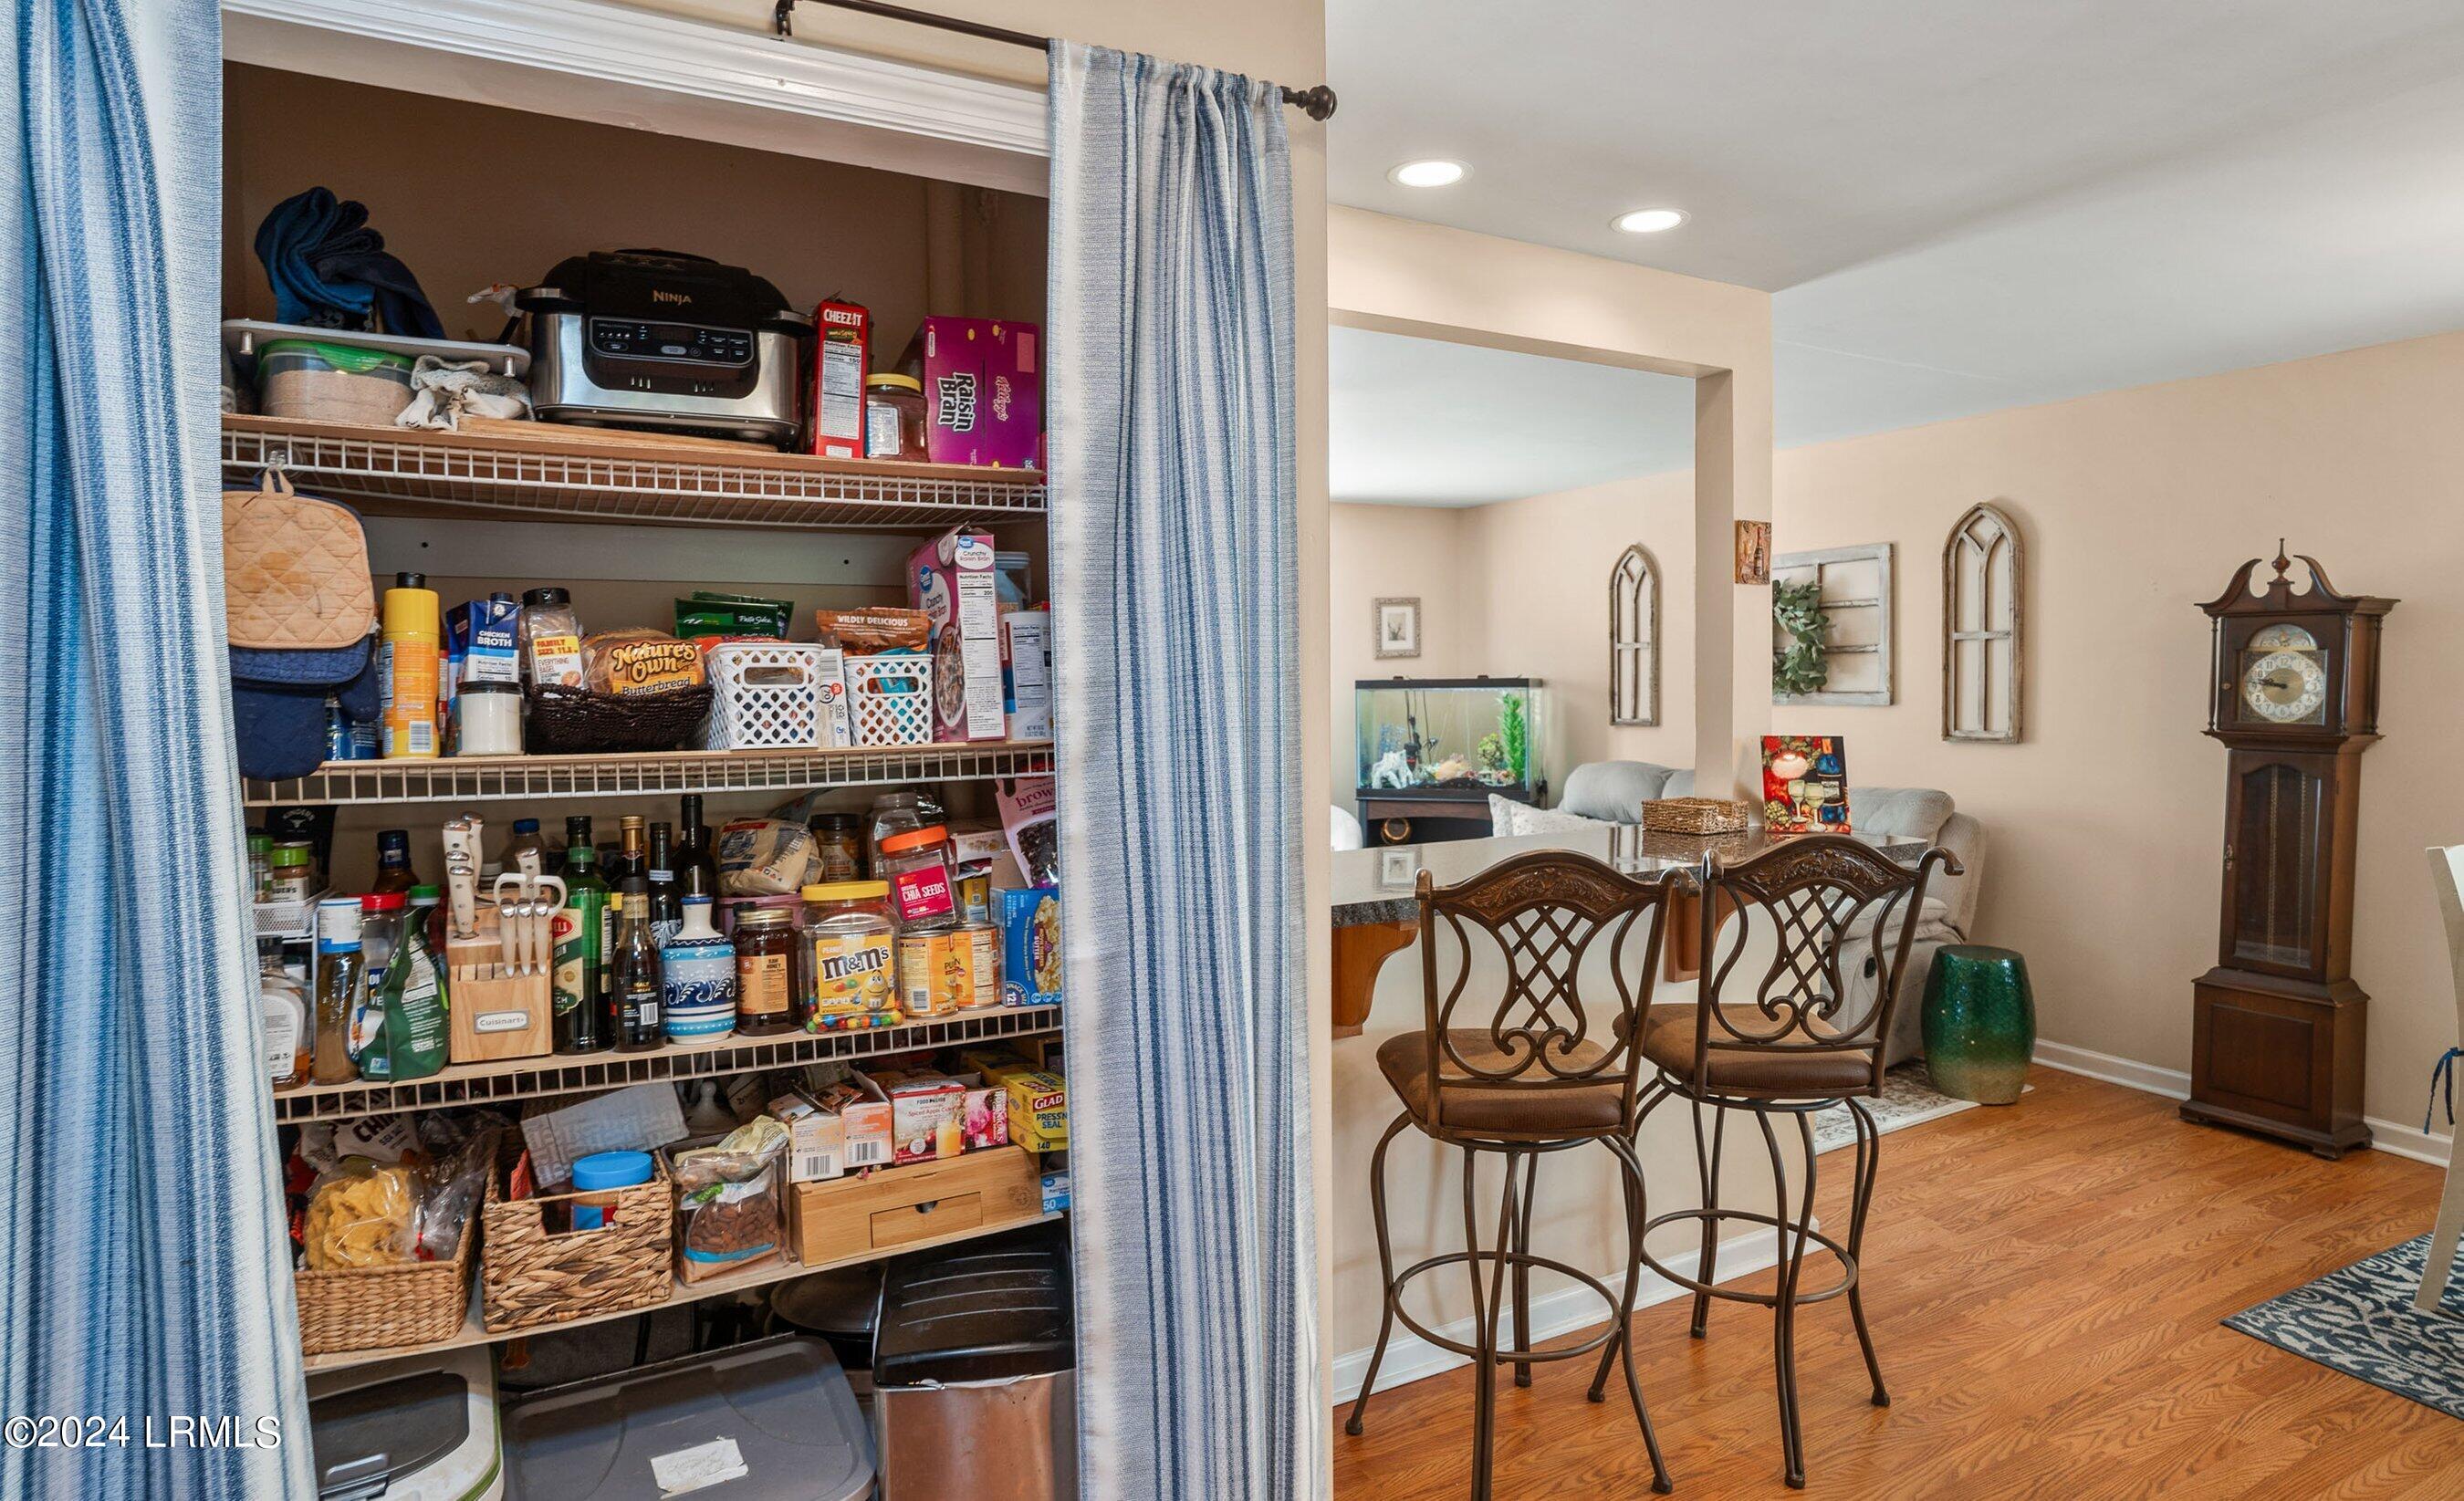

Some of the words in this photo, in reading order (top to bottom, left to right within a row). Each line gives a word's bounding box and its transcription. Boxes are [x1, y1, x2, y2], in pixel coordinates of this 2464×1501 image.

[653, 289, 693, 307] NINJA
[938, 377, 958, 426] Bran
[954, 373, 976, 432] Raisin
[837, 615, 865, 624] WILDLY
[866, 616, 909, 627] DELICIOUS
[476, 636, 513, 647] BROTH
[478, 630, 511, 639] CHICKEN
[538, 657, 570, 667] EVERYTHING
[611, 641, 697, 672] Nature's
[631, 657, 679, 683] Own
[621, 676, 691, 695] Butterbread
[1016, 787, 1055, 808] brow
[902, 888, 922, 902] CHIA
[921, 881, 946, 898] SEEDS
[479, 1017, 520, 1027] Cuisinart
[1033, 1095, 1063, 1110] GLAD
[1041, 1121, 1063, 1129] SEAL
[1037, 1141, 1051, 1150] 140
[1043, 1198, 1057, 1211] 50
